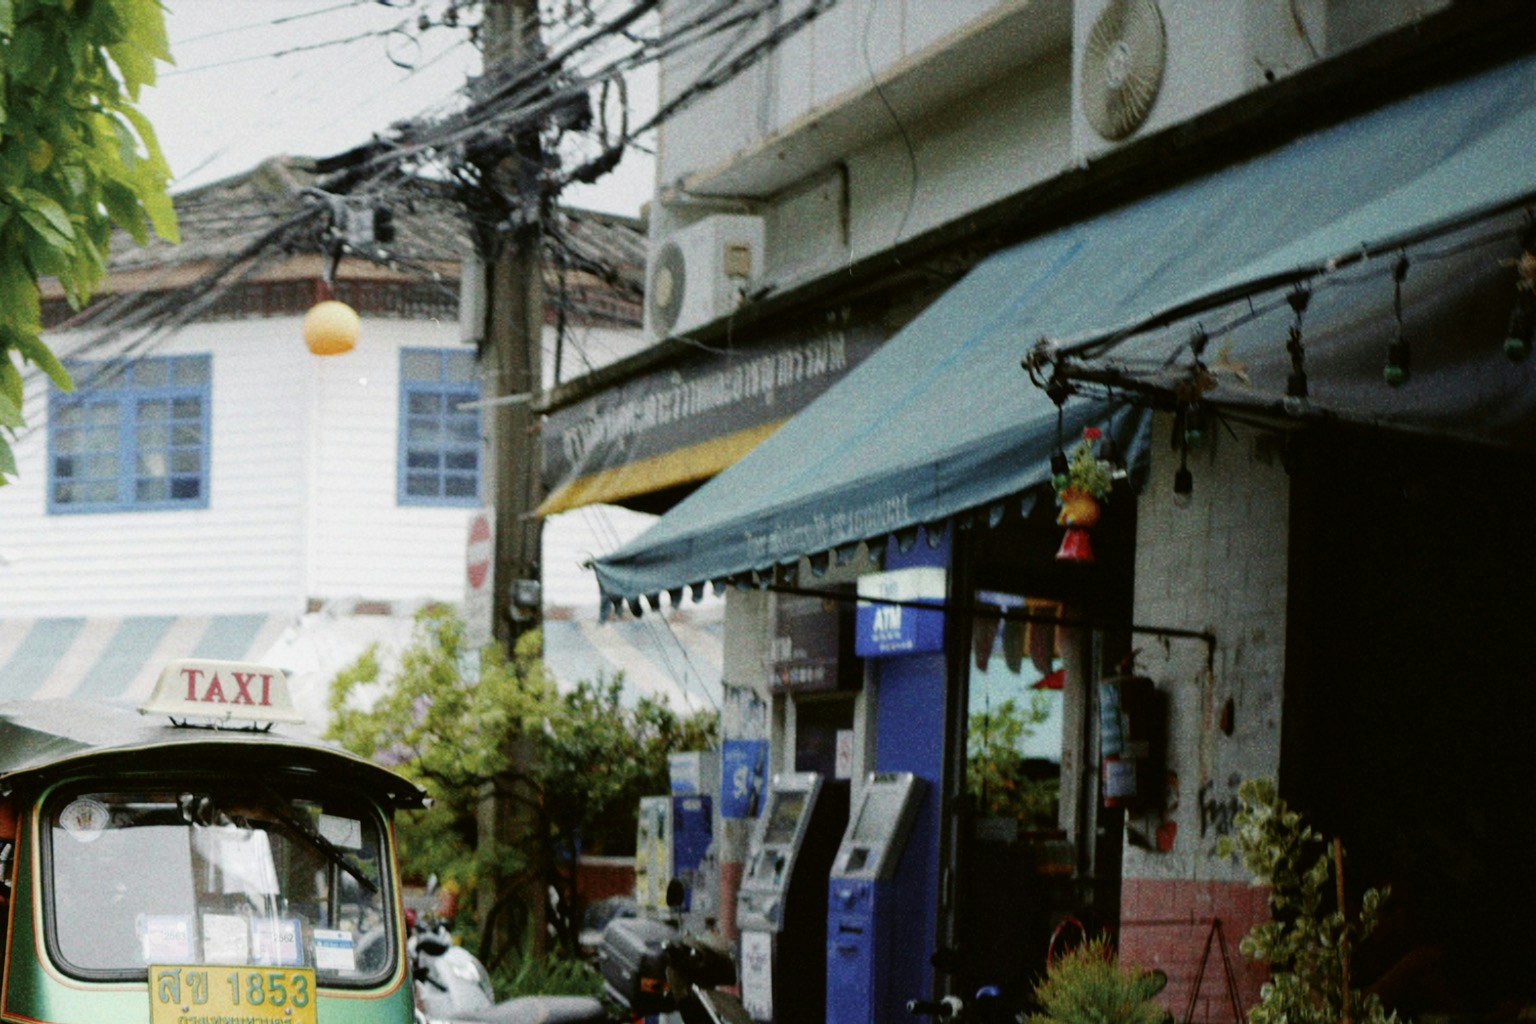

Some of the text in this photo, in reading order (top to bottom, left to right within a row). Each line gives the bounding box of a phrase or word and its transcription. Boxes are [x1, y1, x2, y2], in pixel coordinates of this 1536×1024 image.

[873, 604, 902, 631] ATM
[180, 668, 274, 706] TAXI
[227, 971, 309, 1008] 1853
